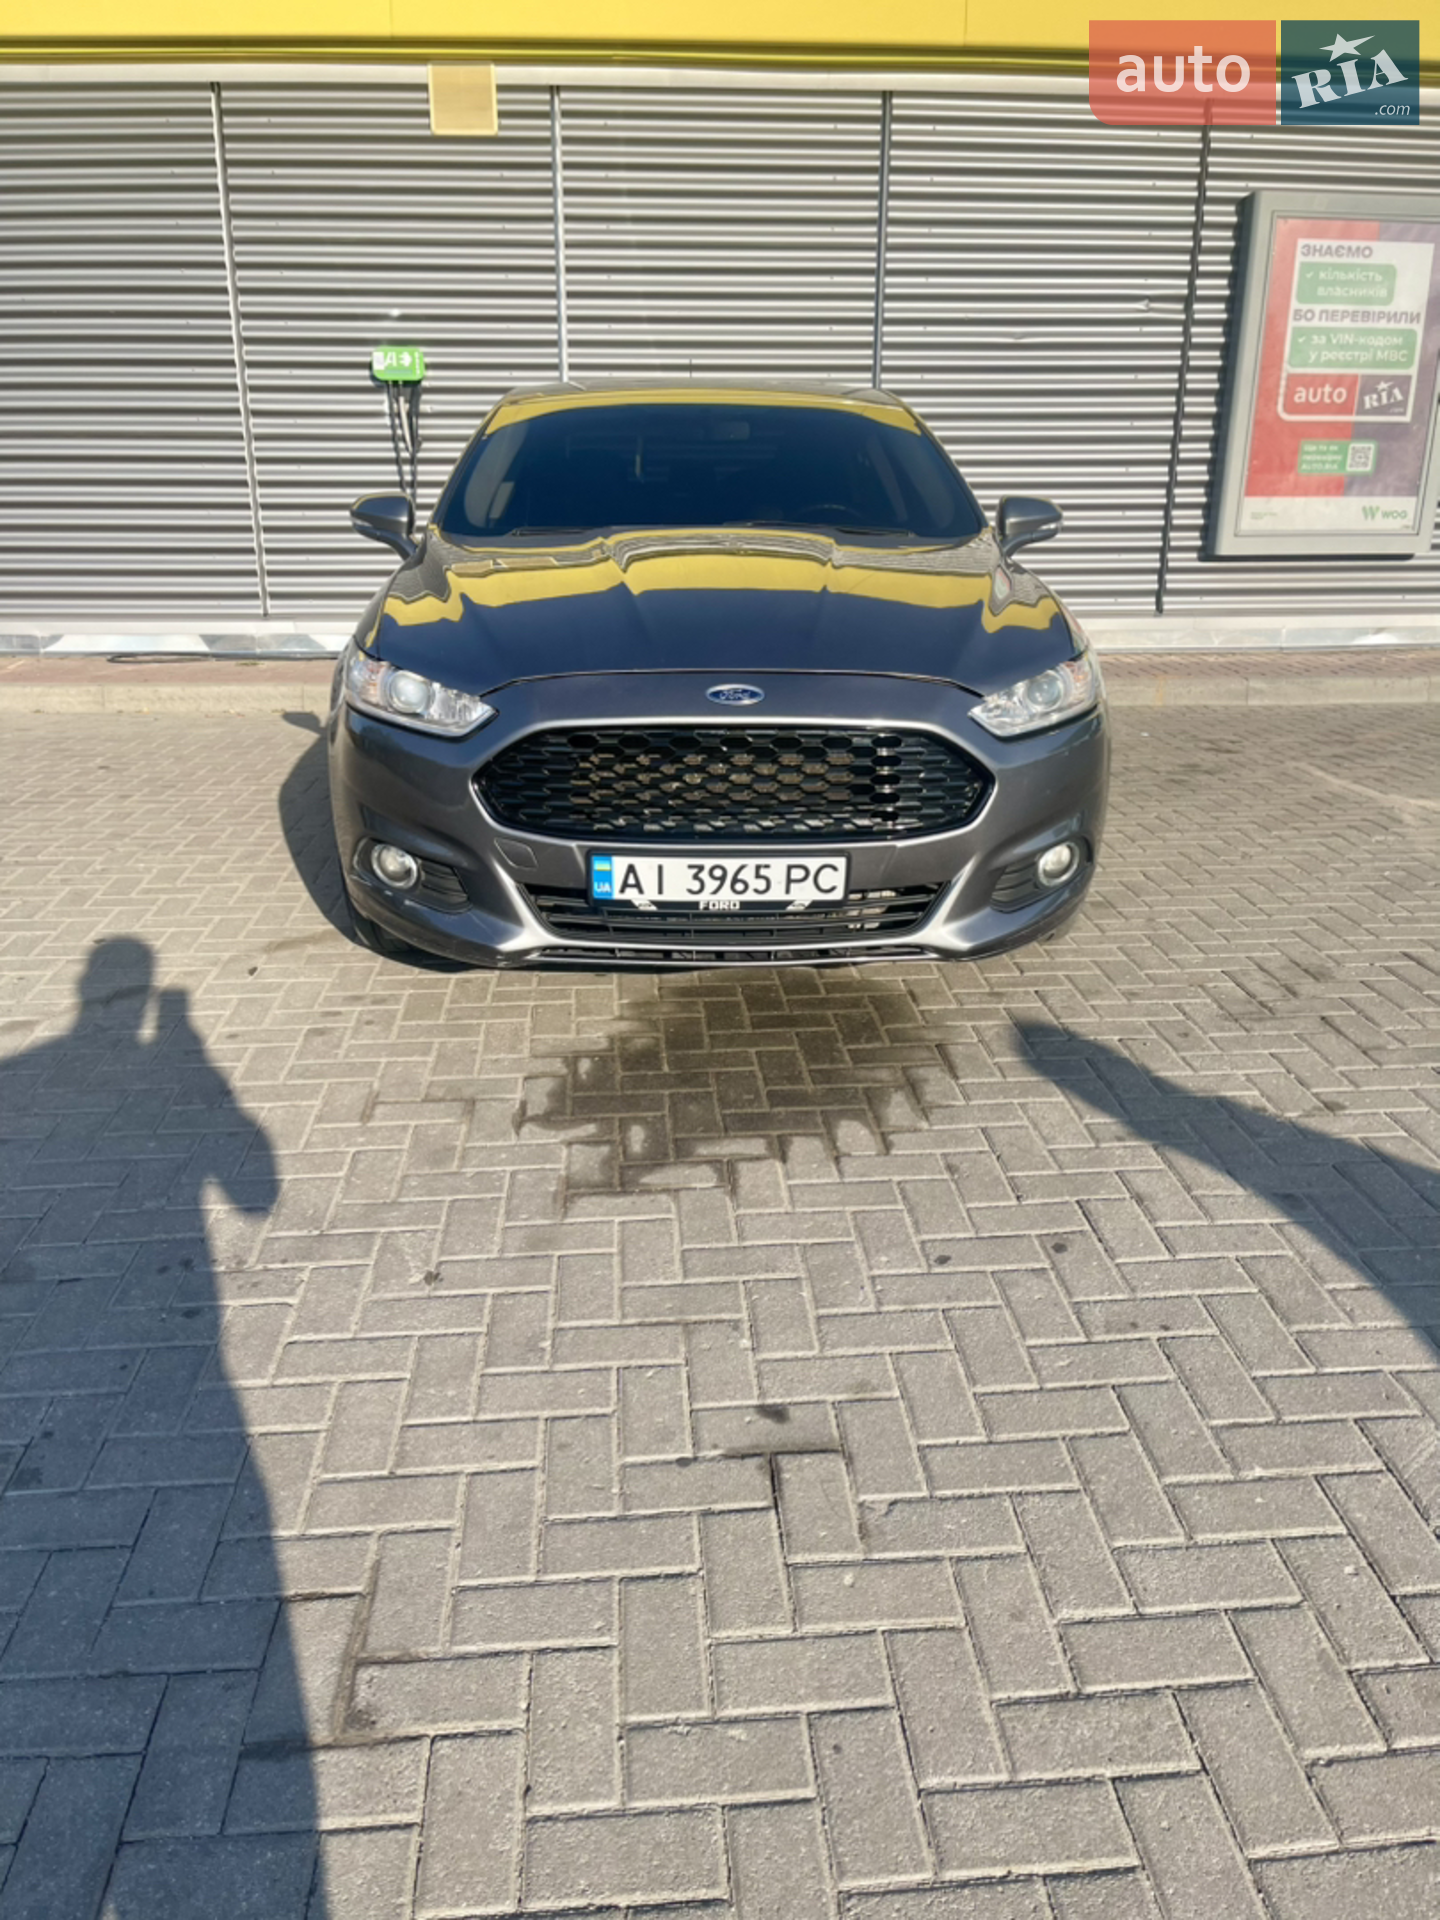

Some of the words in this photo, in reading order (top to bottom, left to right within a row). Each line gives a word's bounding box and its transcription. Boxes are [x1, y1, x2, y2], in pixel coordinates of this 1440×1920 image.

[1301, 244, 1373, 258] ЗНАЄМО
[1319, 268, 1383, 282] кількість
[1293, 309, 1315, 321] БО
[1319, 310, 1421, 324] ПЕРЕВІРИЛИ
[1310, 335, 1327, 345] за
[1294, 384, 1347, 403] auto
[1363, 387, 1404, 409] RIA
[619, 863, 664, 895] AI
[686, 864, 772, 895] 3965
[785, 864, 839, 894] PC
[699, 901, 740, 911] FORD
